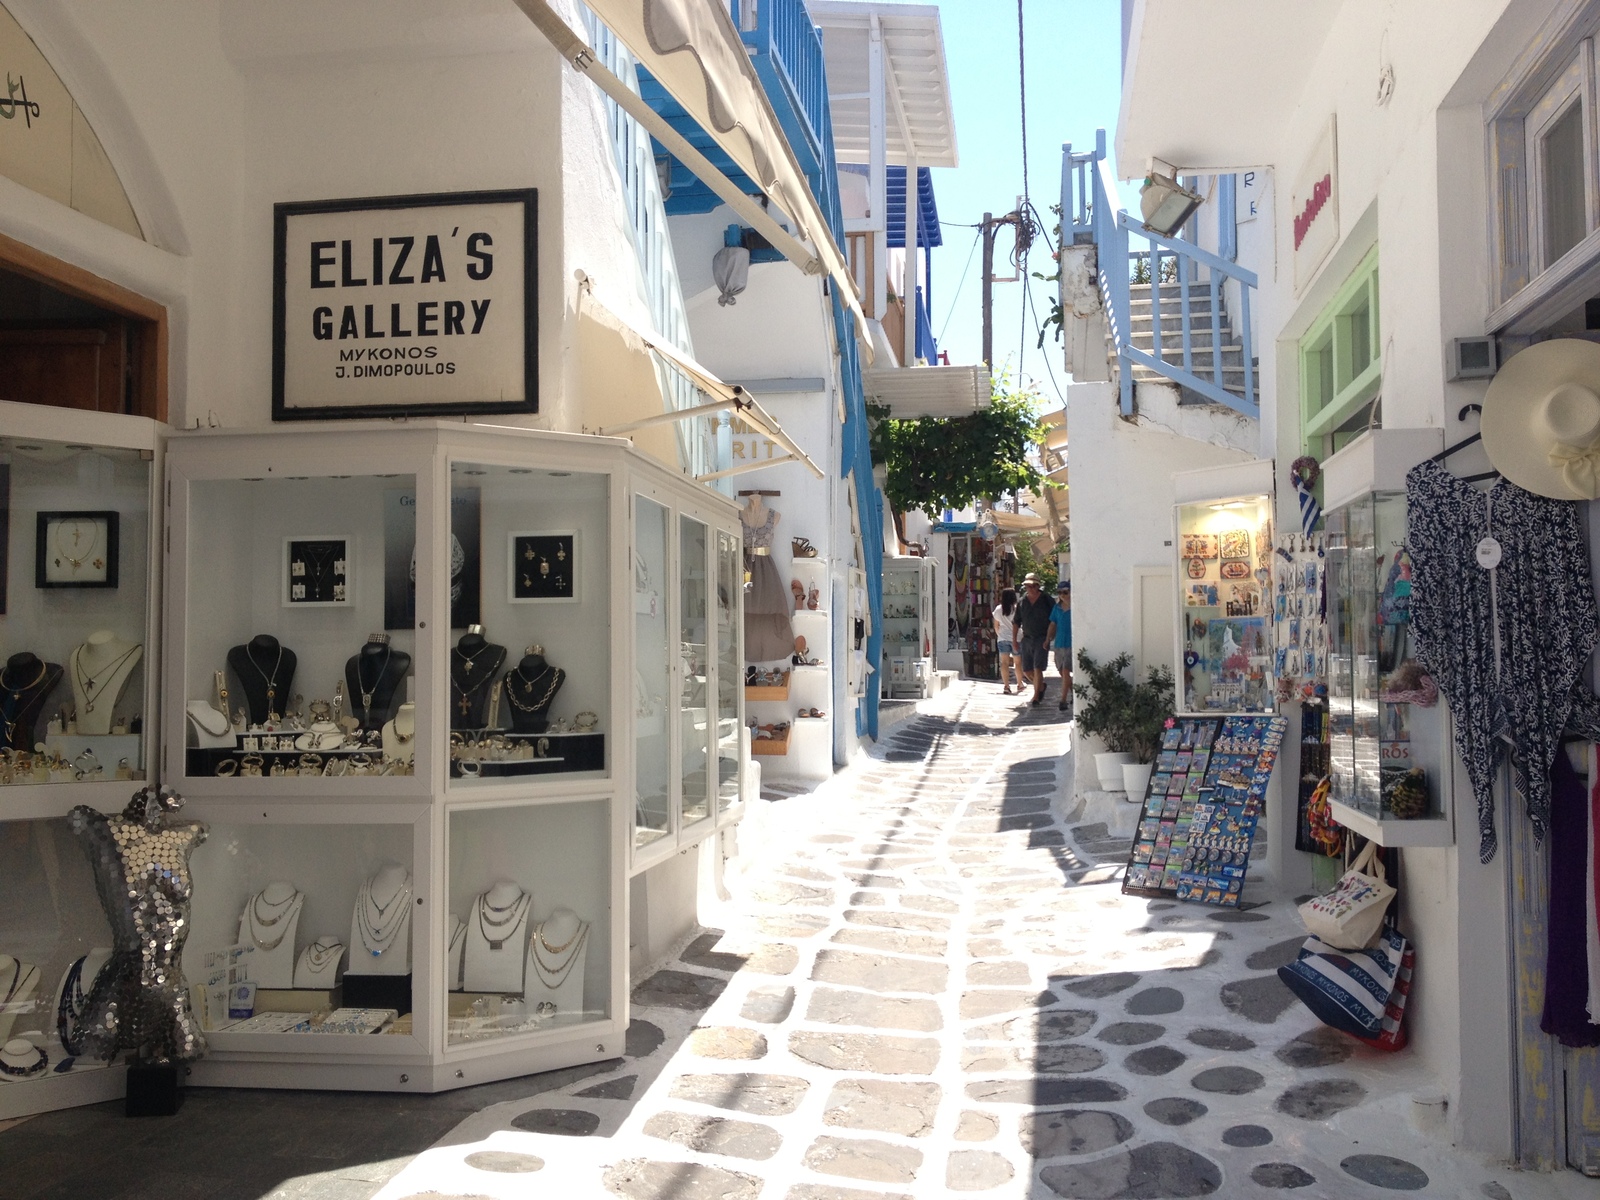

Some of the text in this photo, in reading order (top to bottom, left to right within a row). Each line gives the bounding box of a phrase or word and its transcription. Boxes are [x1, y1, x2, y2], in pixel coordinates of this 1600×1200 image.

[310, 226, 494, 289] ELIZA'S
[312, 299, 492, 341] GALLERY
[339, 346, 438, 362] MYKONOS
[1316, 977, 1350, 1003] MYKONOS
